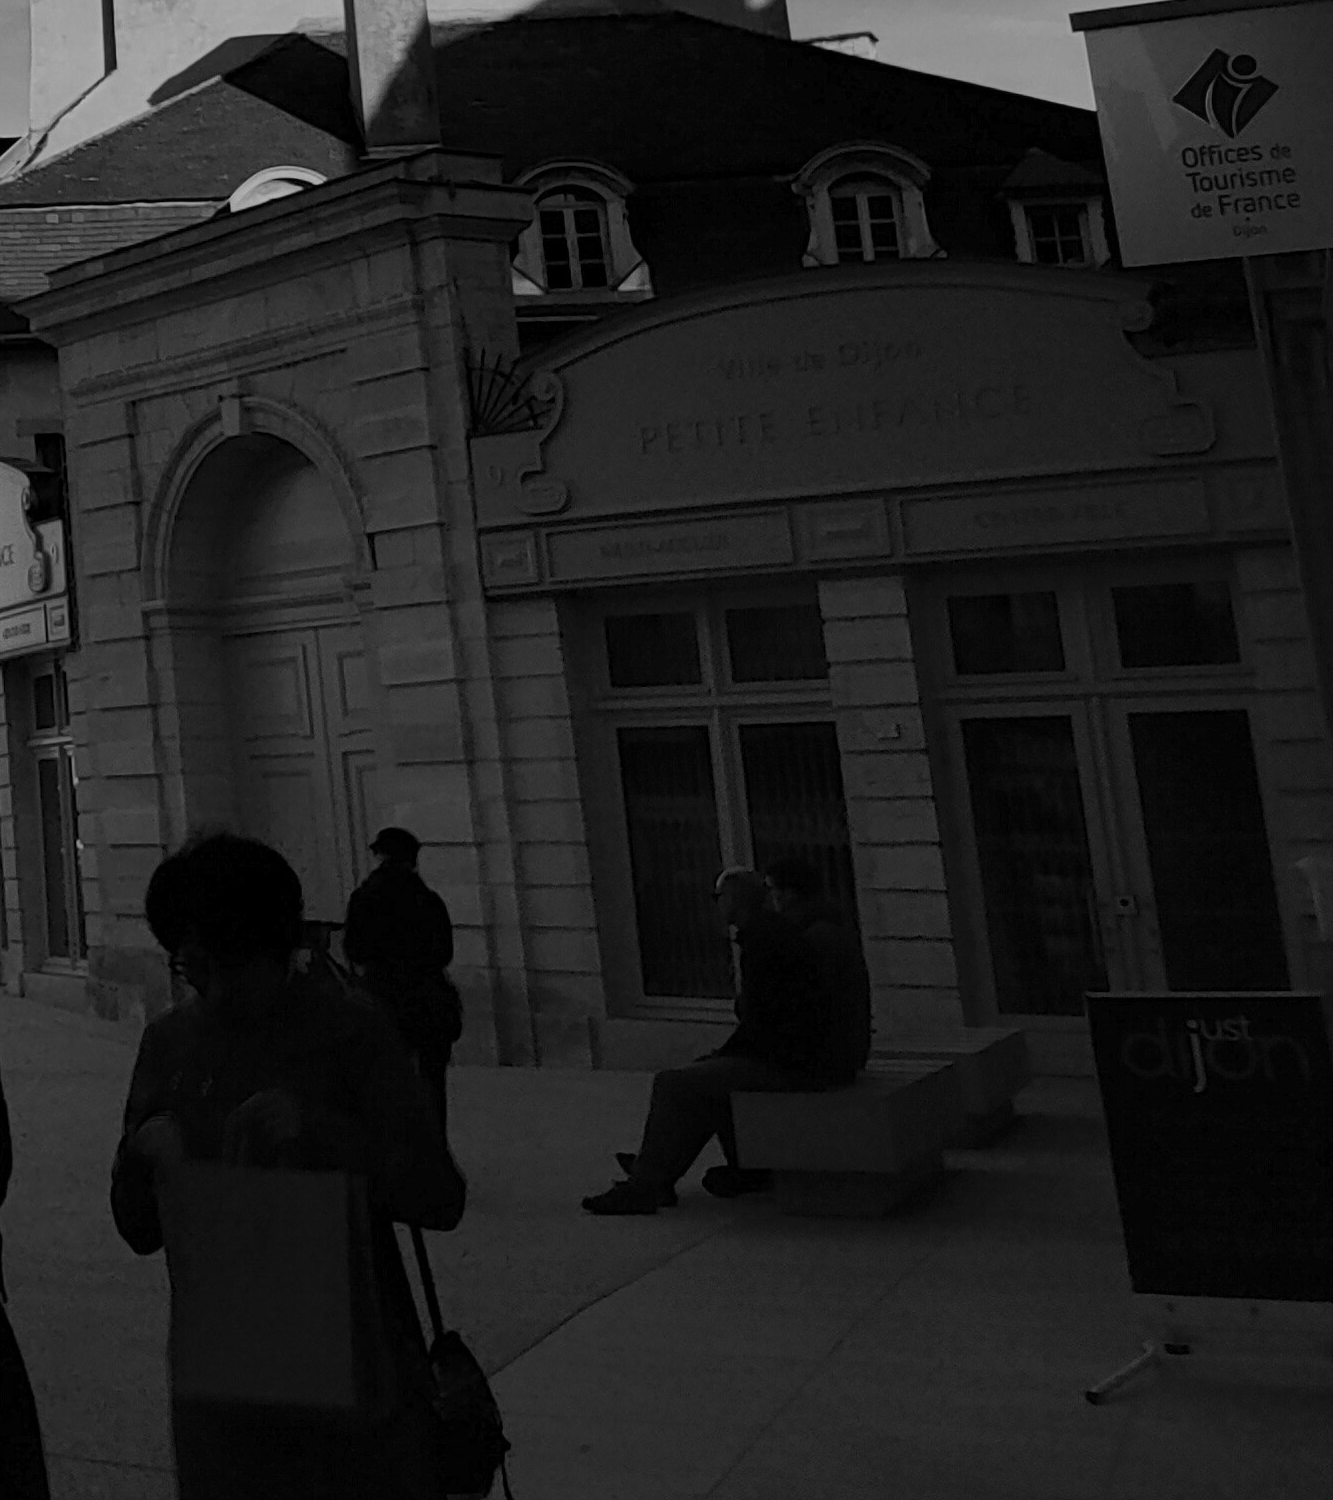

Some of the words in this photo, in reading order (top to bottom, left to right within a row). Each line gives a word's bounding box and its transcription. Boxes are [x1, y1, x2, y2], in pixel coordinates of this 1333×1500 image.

[1181, 144, 1263, 168] Offices
[1269, 143, 1292, 160] de
[1185, 167, 1297, 193] Tourisme
[1190, 202, 1213, 219] de
[1218, 193, 1301, 216] France
[1232, 224, 1268, 239] Dijon
[837, 340, 923, 372] Dijon
[639, 411, 779, 455] PETITE
[805, 383, 1033, 439] ENFANCE
[1121, 1015, 1312, 1094] dijon
